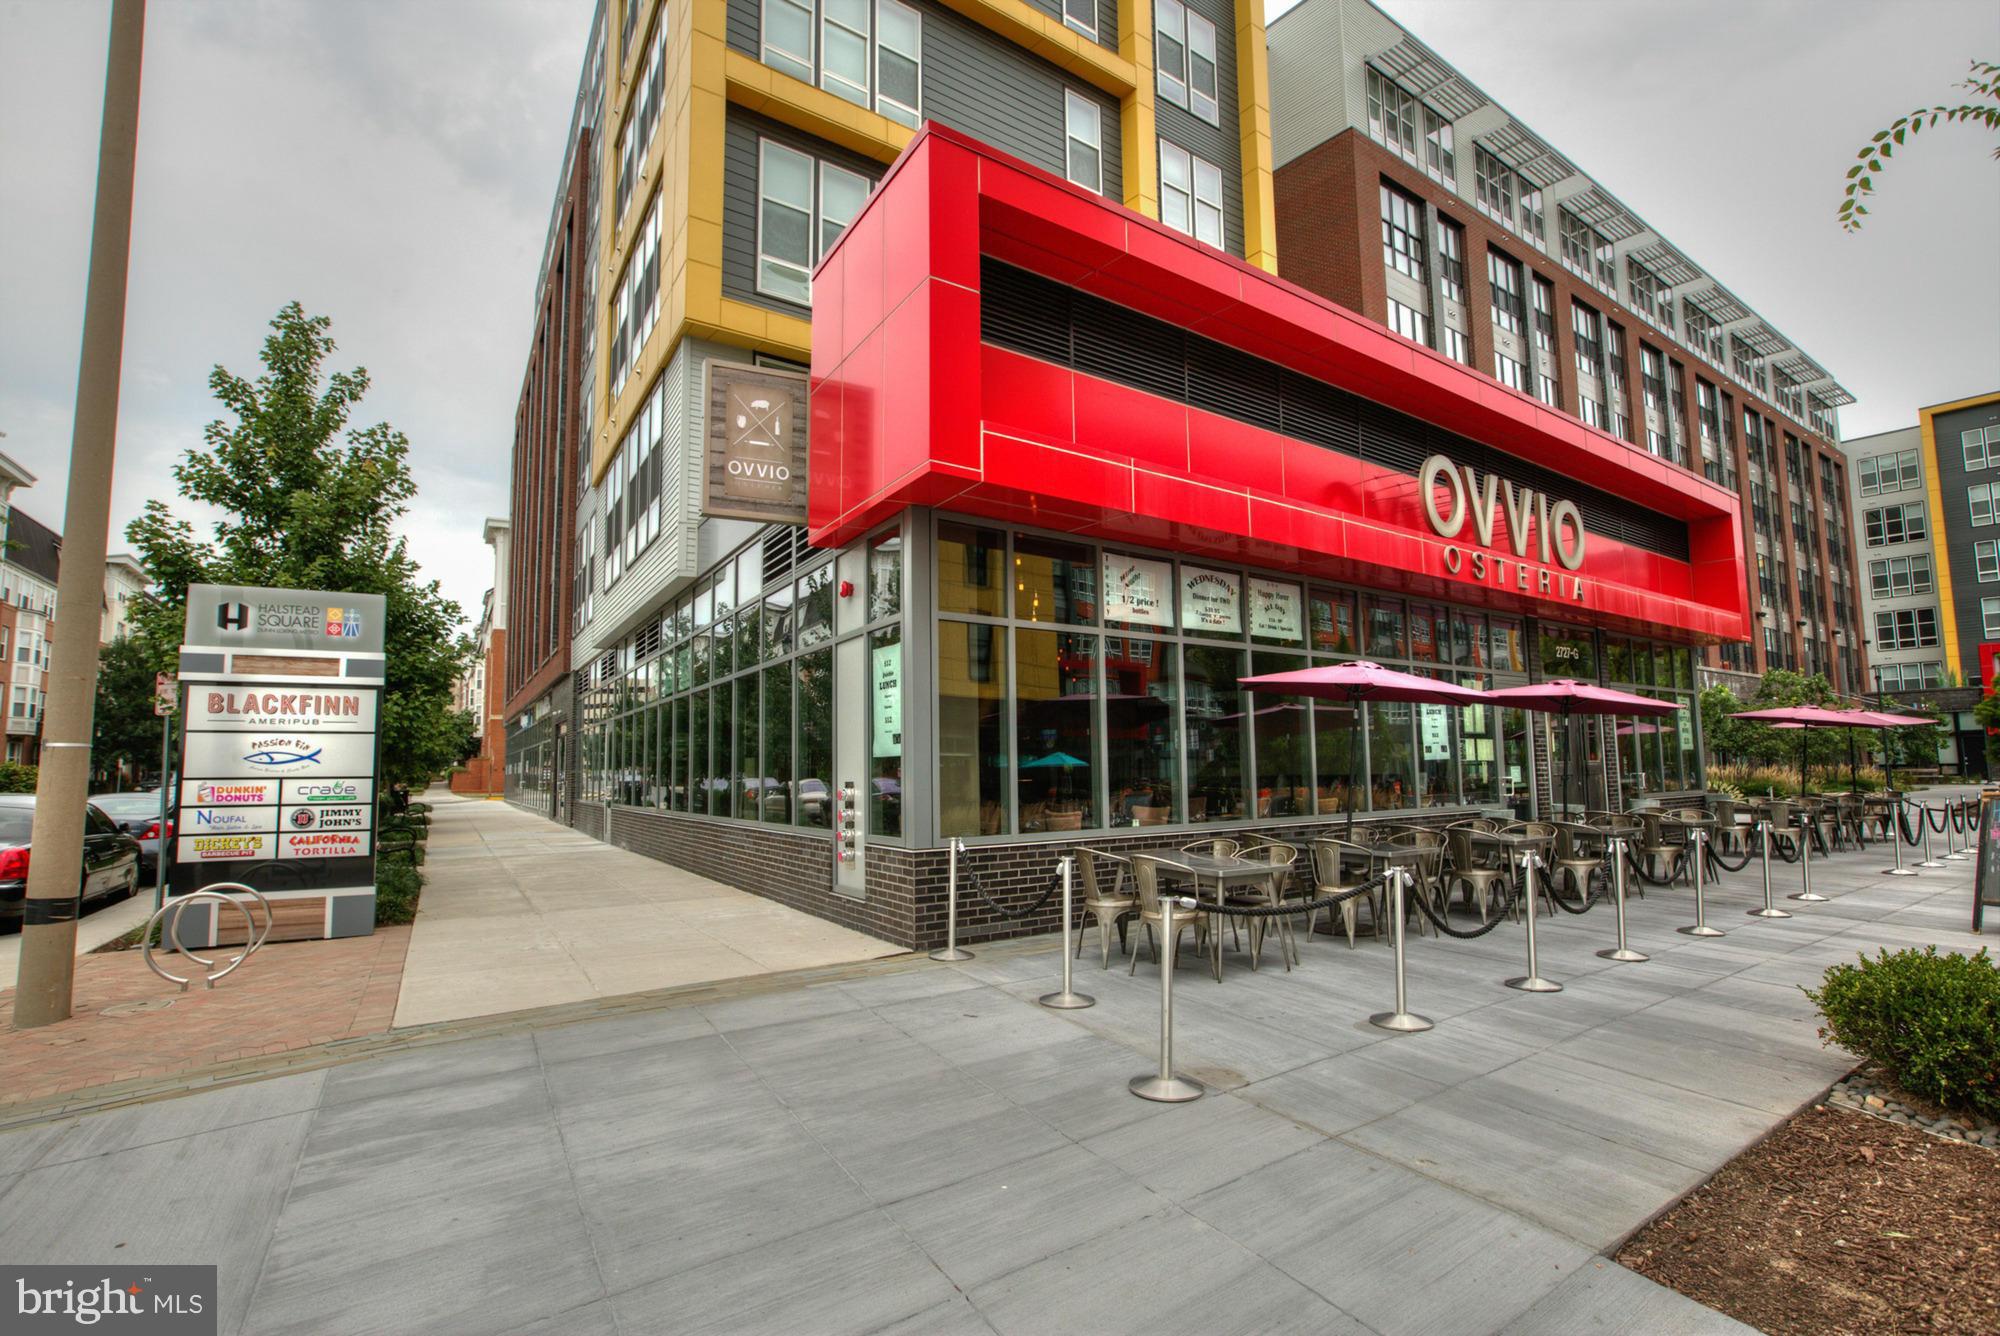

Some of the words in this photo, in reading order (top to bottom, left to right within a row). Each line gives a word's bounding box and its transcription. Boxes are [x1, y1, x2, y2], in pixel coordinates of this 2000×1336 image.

[728, 460, 790, 480] OVVIO
[1419, 454, 1586, 570] OVVIO
[1444, 545, 1585, 601] OSTERIA
[1187, 574, 1236, 596] WEDNESDAY
[258, 604, 320, 616] HALSTEAD
[258, 614, 319, 628] SQUARE
[207, 692, 360, 716] BLACKFINN
[249, 718, 320, 726] AMERIPUB
[215, 794, 264, 802] DONUTS
[197, 810, 246, 824] NOUFAL
[320, 809, 362, 818] JIMMY
[319, 819, 361, 828] JOHN'S
[194, 837, 263, 851] DICKEY'S
[289, 834, 360, 846] CALIFORNIA
[294, 847, 356, 856] TORTILLA
